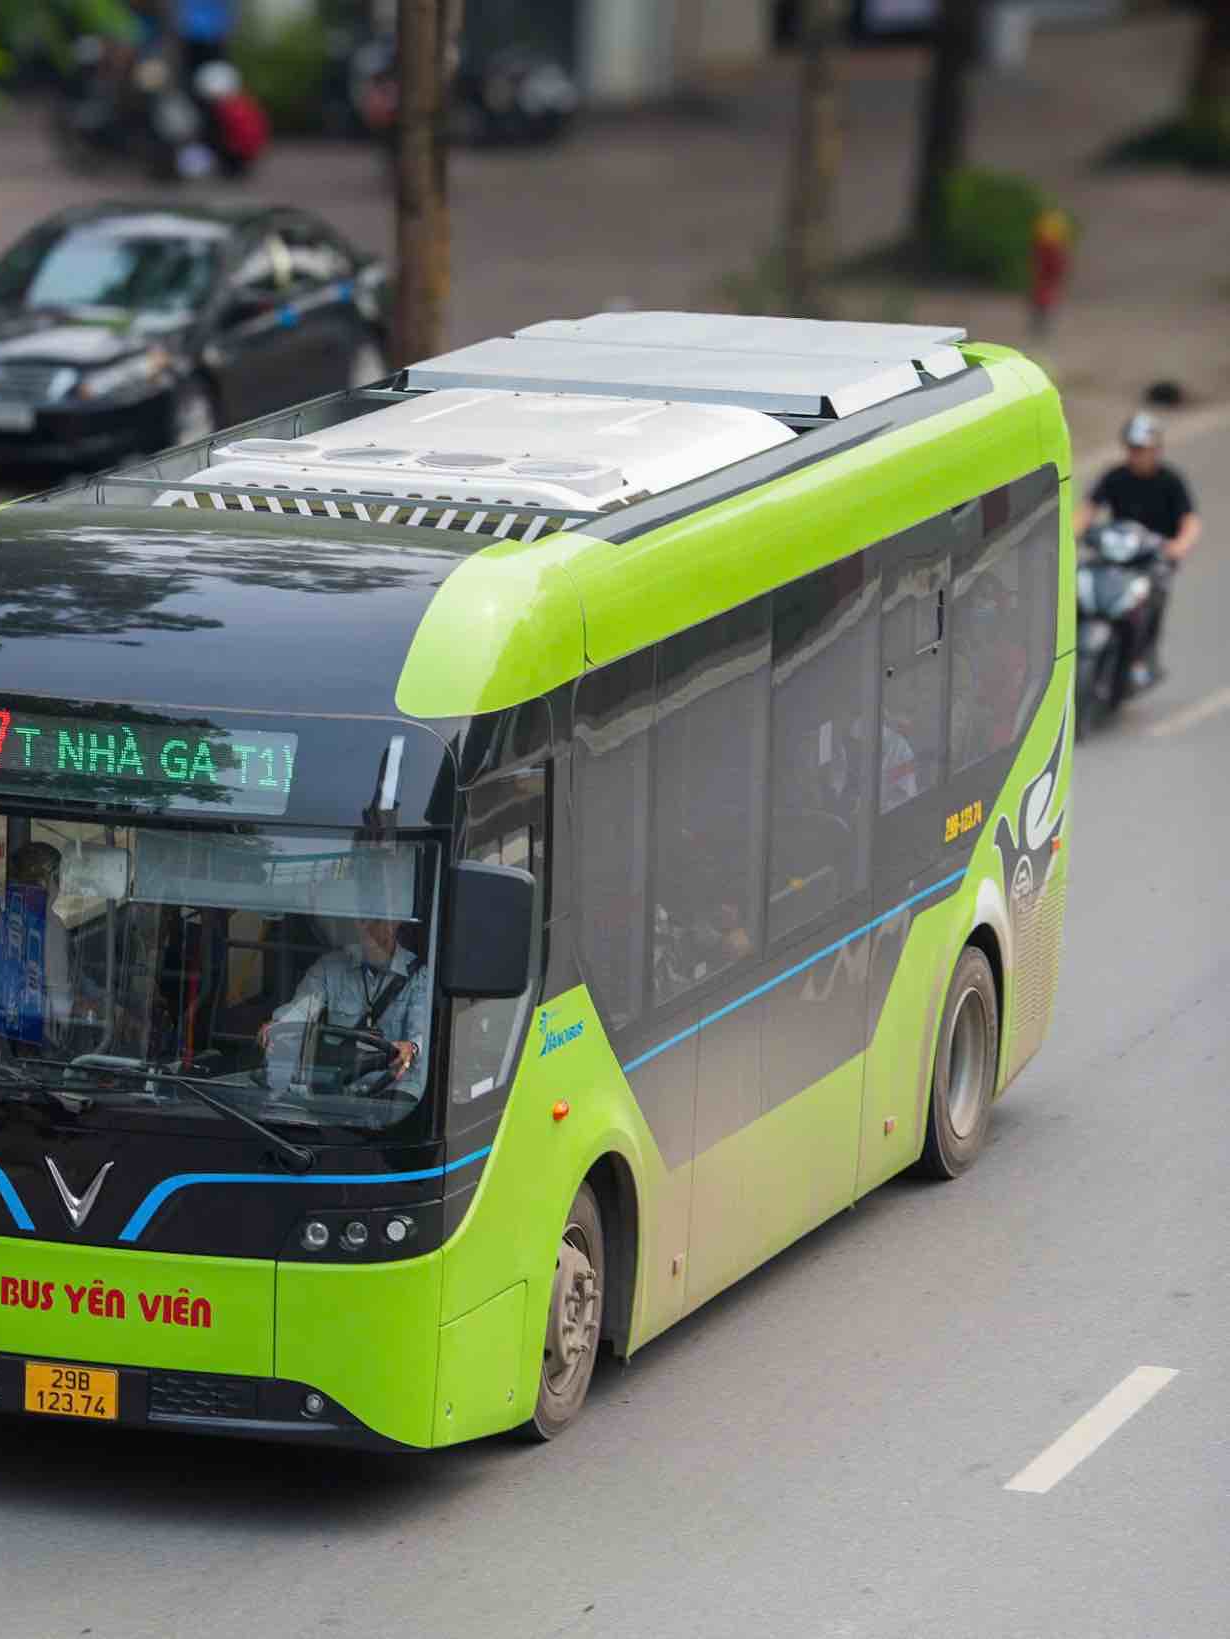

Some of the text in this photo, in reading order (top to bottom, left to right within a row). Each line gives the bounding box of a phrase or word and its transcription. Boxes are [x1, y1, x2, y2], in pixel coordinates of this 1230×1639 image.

[57, 726, 145, 777] NHÀ
[0, 1275, 55, 1311] BUS
[63, 1279, 126, 1320] YÊN
[137, 1287, 212, 1329] VIÊN
[50, 1368, 91, 1392] 29B
[36, 1390, 106, 1416] 123.74
